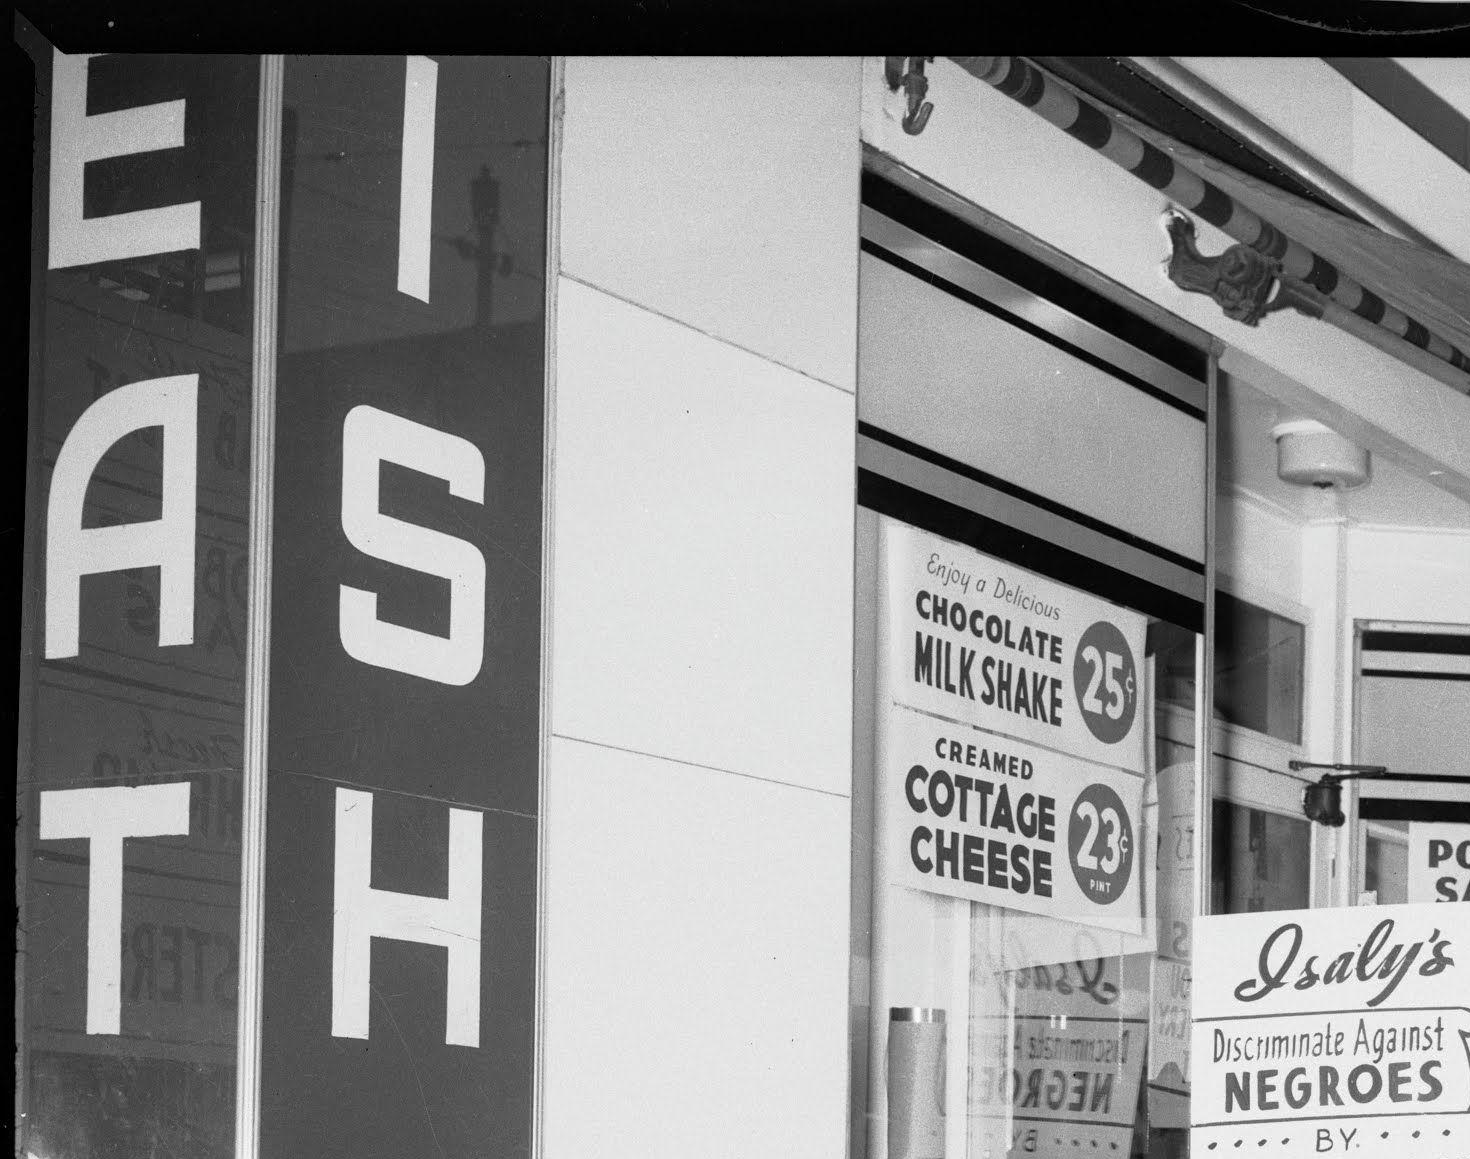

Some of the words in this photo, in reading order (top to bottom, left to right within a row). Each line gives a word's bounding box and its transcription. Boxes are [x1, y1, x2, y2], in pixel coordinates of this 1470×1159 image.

[926, 553, 971, 589] Enjoy
[976, 576, 986, 592] a
[994, 578, 1061, 621] Delicious
[916, 590, 1062, 664] CHOCOLATE
[935, 737, 1034, 781] CREAMED
[905, 765, 1055, 842] COTTAGE
[910, 826, 1053, 898] CHEESE
[1090, 879, 1111, 893] PINT
[1234, 919, 1454, 1007] Isaly's
[1214, 1023, 1345, 1063] Discriminate
[1353, 1017, 1445, 1063] Against
[1225, 1060, 1442, 1113] NEGROES
